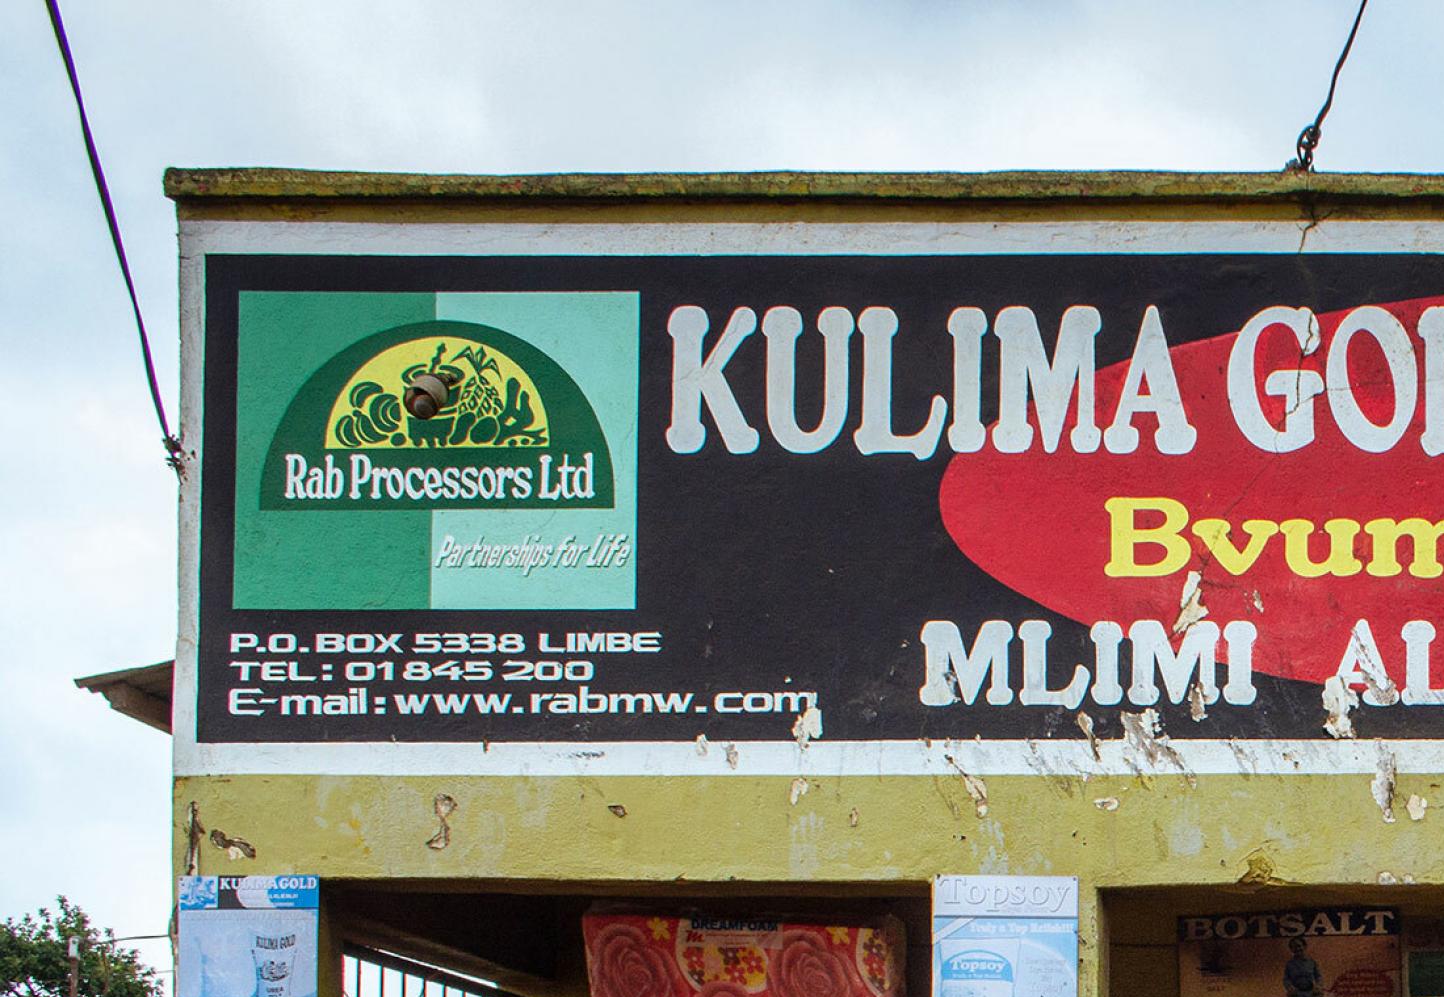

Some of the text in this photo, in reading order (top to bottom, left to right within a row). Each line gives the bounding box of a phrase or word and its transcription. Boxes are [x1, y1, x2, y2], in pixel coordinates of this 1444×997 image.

[665, 304, 1197, 460] KULIMA
[285, 453, 595, 500] Rab Processors Ltd
[434, 534, 630, 577] Partnerships for Life
[412, 632, 526, 653] 5338
[538, 631, 662, 653] LIMBE
[502, 660, 595, 682] 200
[919, 619, 1258, 708] MLIMI
[940, 878, 1071, 913] Topsoy
[1184, 910, 1395, 940] BOTSALT
[951, 960, 1005, 973] Topsoy
